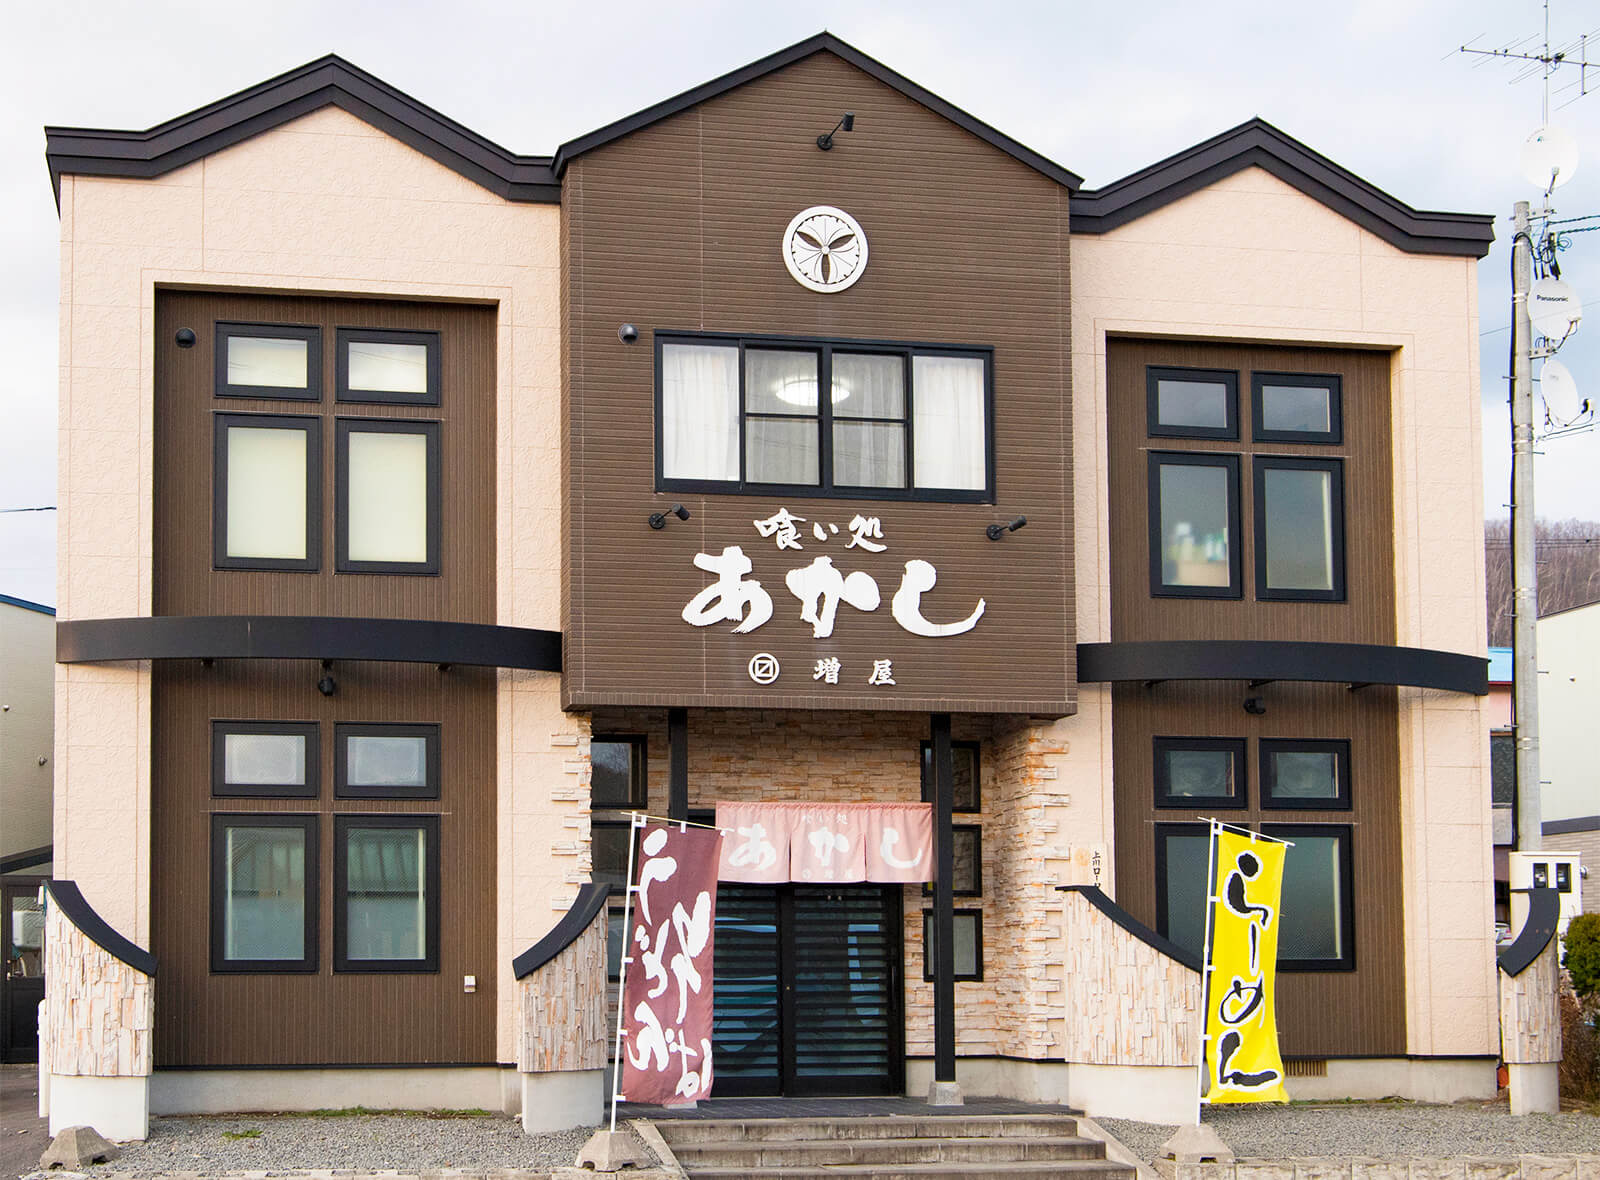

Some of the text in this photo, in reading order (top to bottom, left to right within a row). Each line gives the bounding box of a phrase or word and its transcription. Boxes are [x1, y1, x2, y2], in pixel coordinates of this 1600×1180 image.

[1536, 294, 1568, 302] Panasonic
[753, 508, 888, 553] 喰い処
[682, 546, 986, 639] あかし
[813, 657, 897, 686] 増屋
[727, 823, 922, 870] あかし
[1218, 851, 1280, 1089] らーめん
